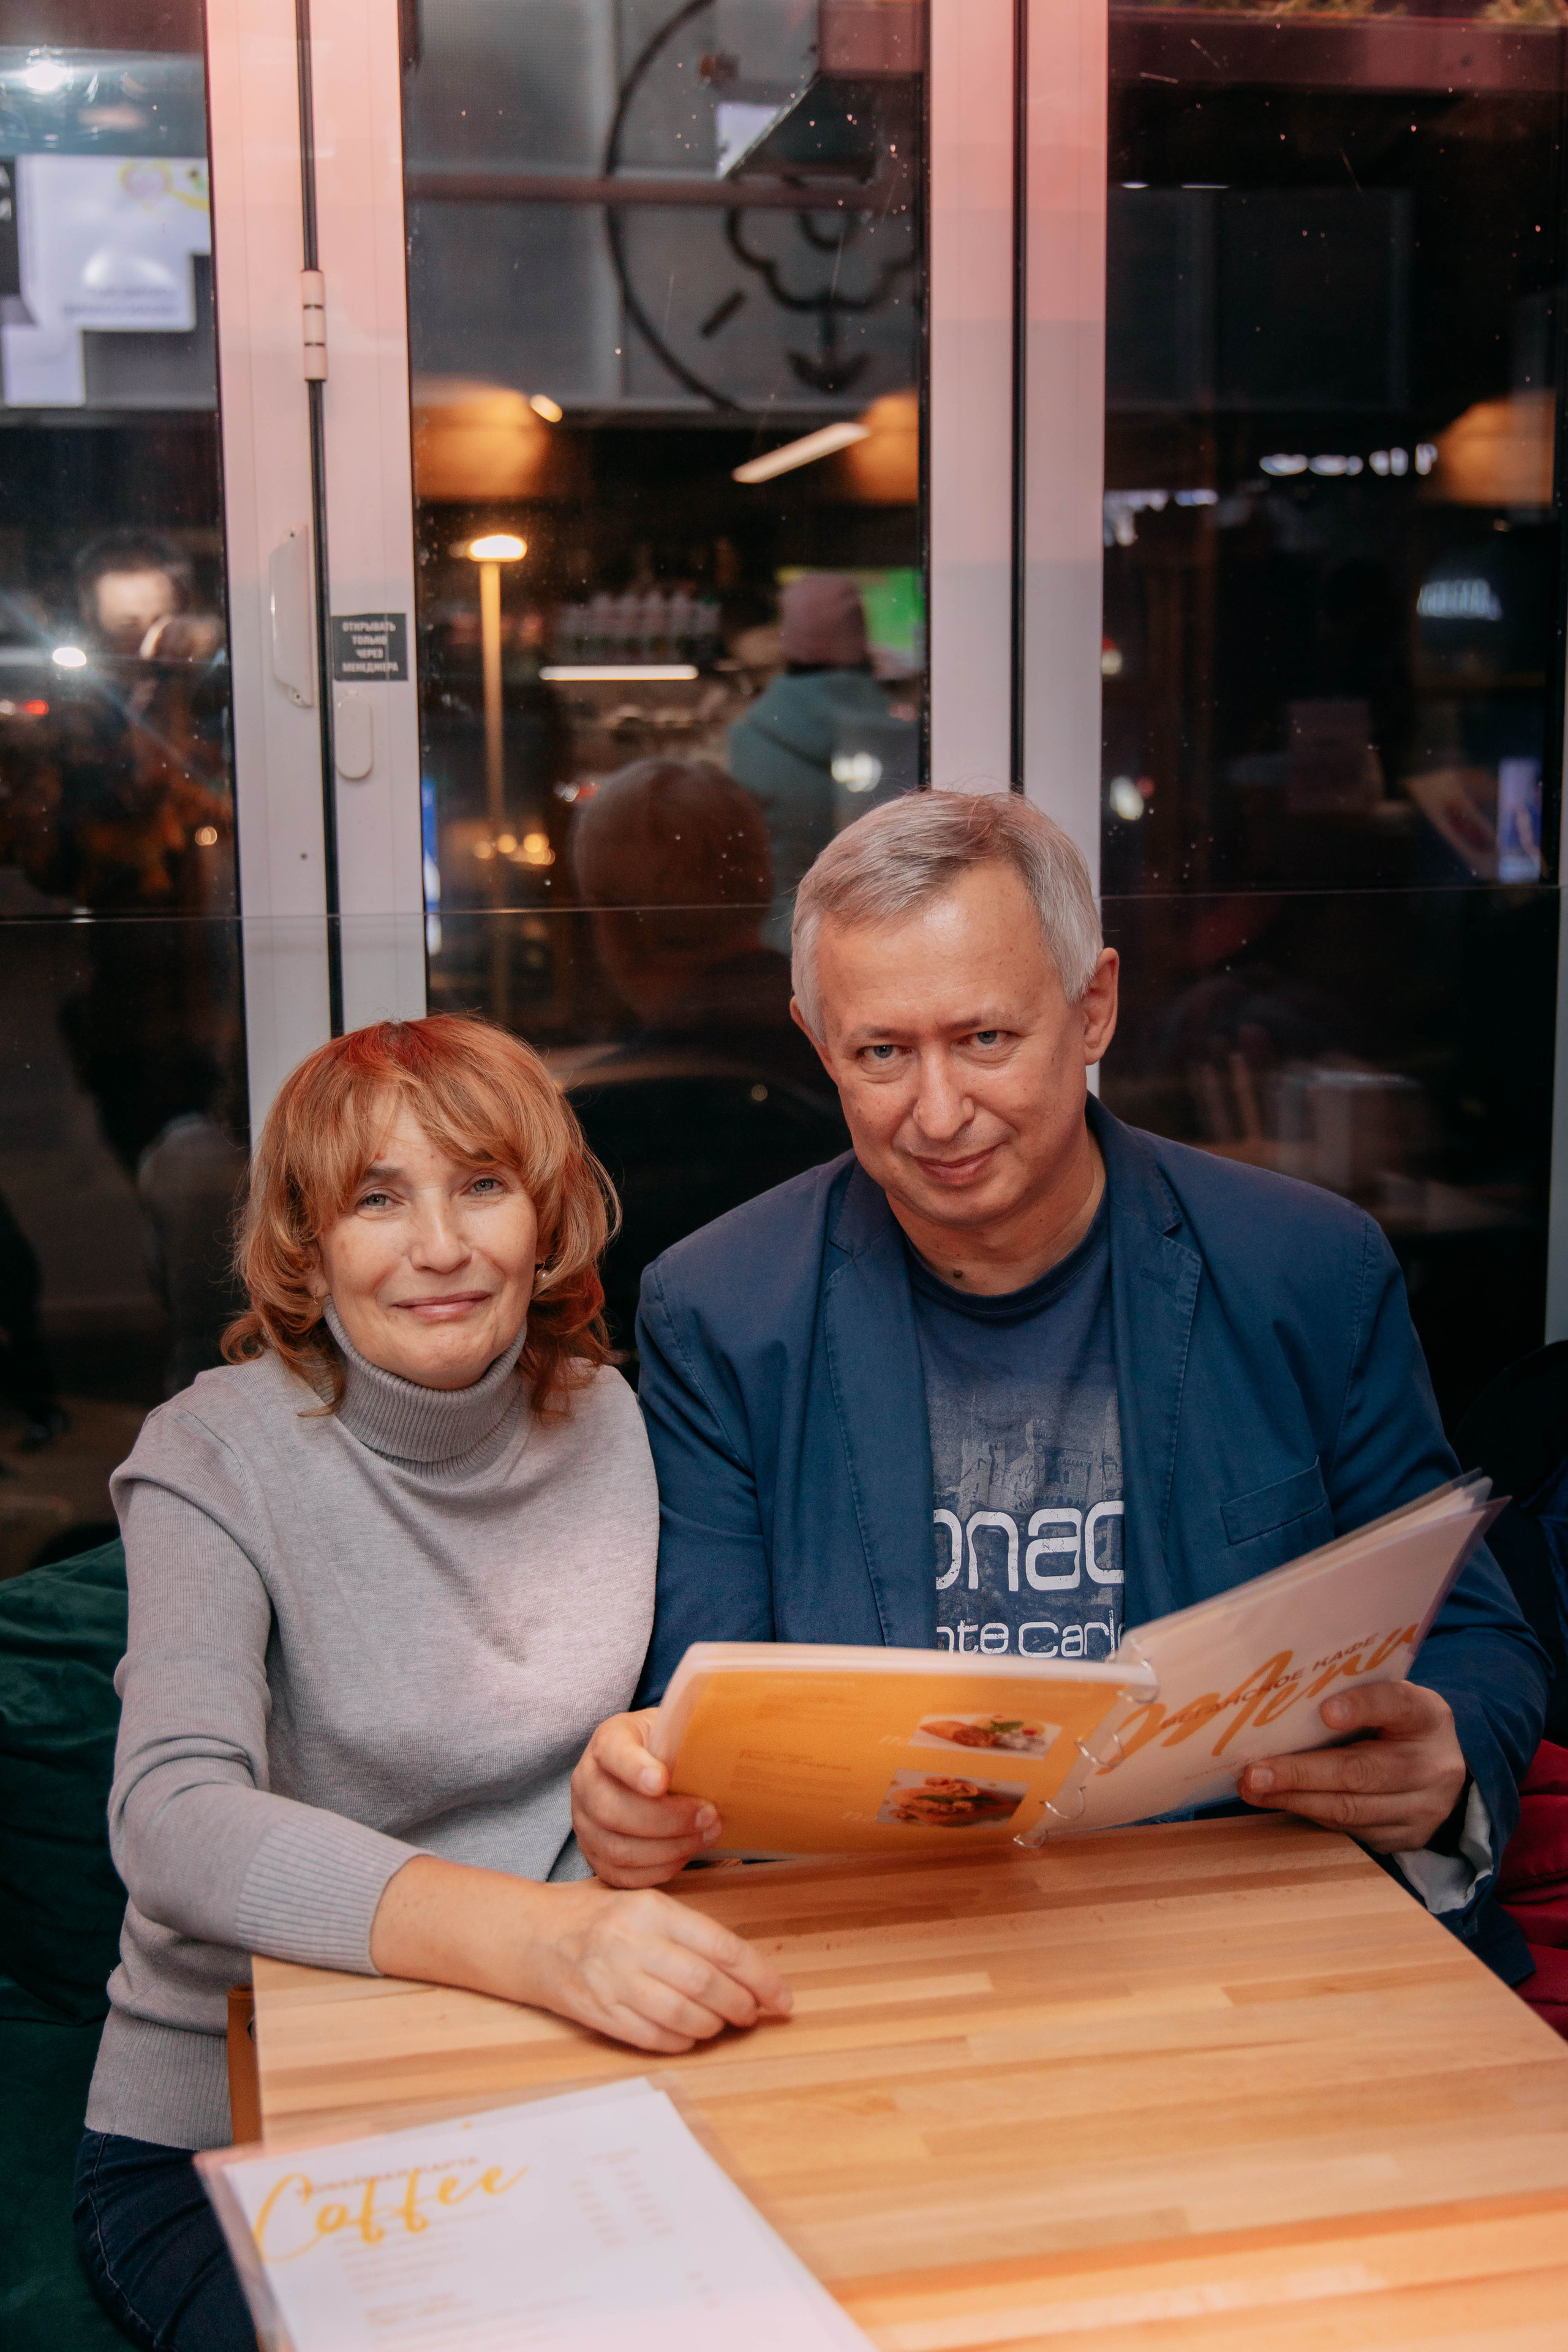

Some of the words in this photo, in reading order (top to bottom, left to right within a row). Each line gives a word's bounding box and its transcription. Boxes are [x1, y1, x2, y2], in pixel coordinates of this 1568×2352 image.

[342, 621, 396, 632] ОТКРЫВАТЬ
[352, 635, 388, 646] ТОЛЬКО
[356, 647, 384, 659] ЧЕРЕЗ
[342, 662, 399, 673] МЕНЕДЖЕРА
[1312, 1632, 1378, 1672] КАФЕ
[254, 2165, 529, 2263] Coffee
